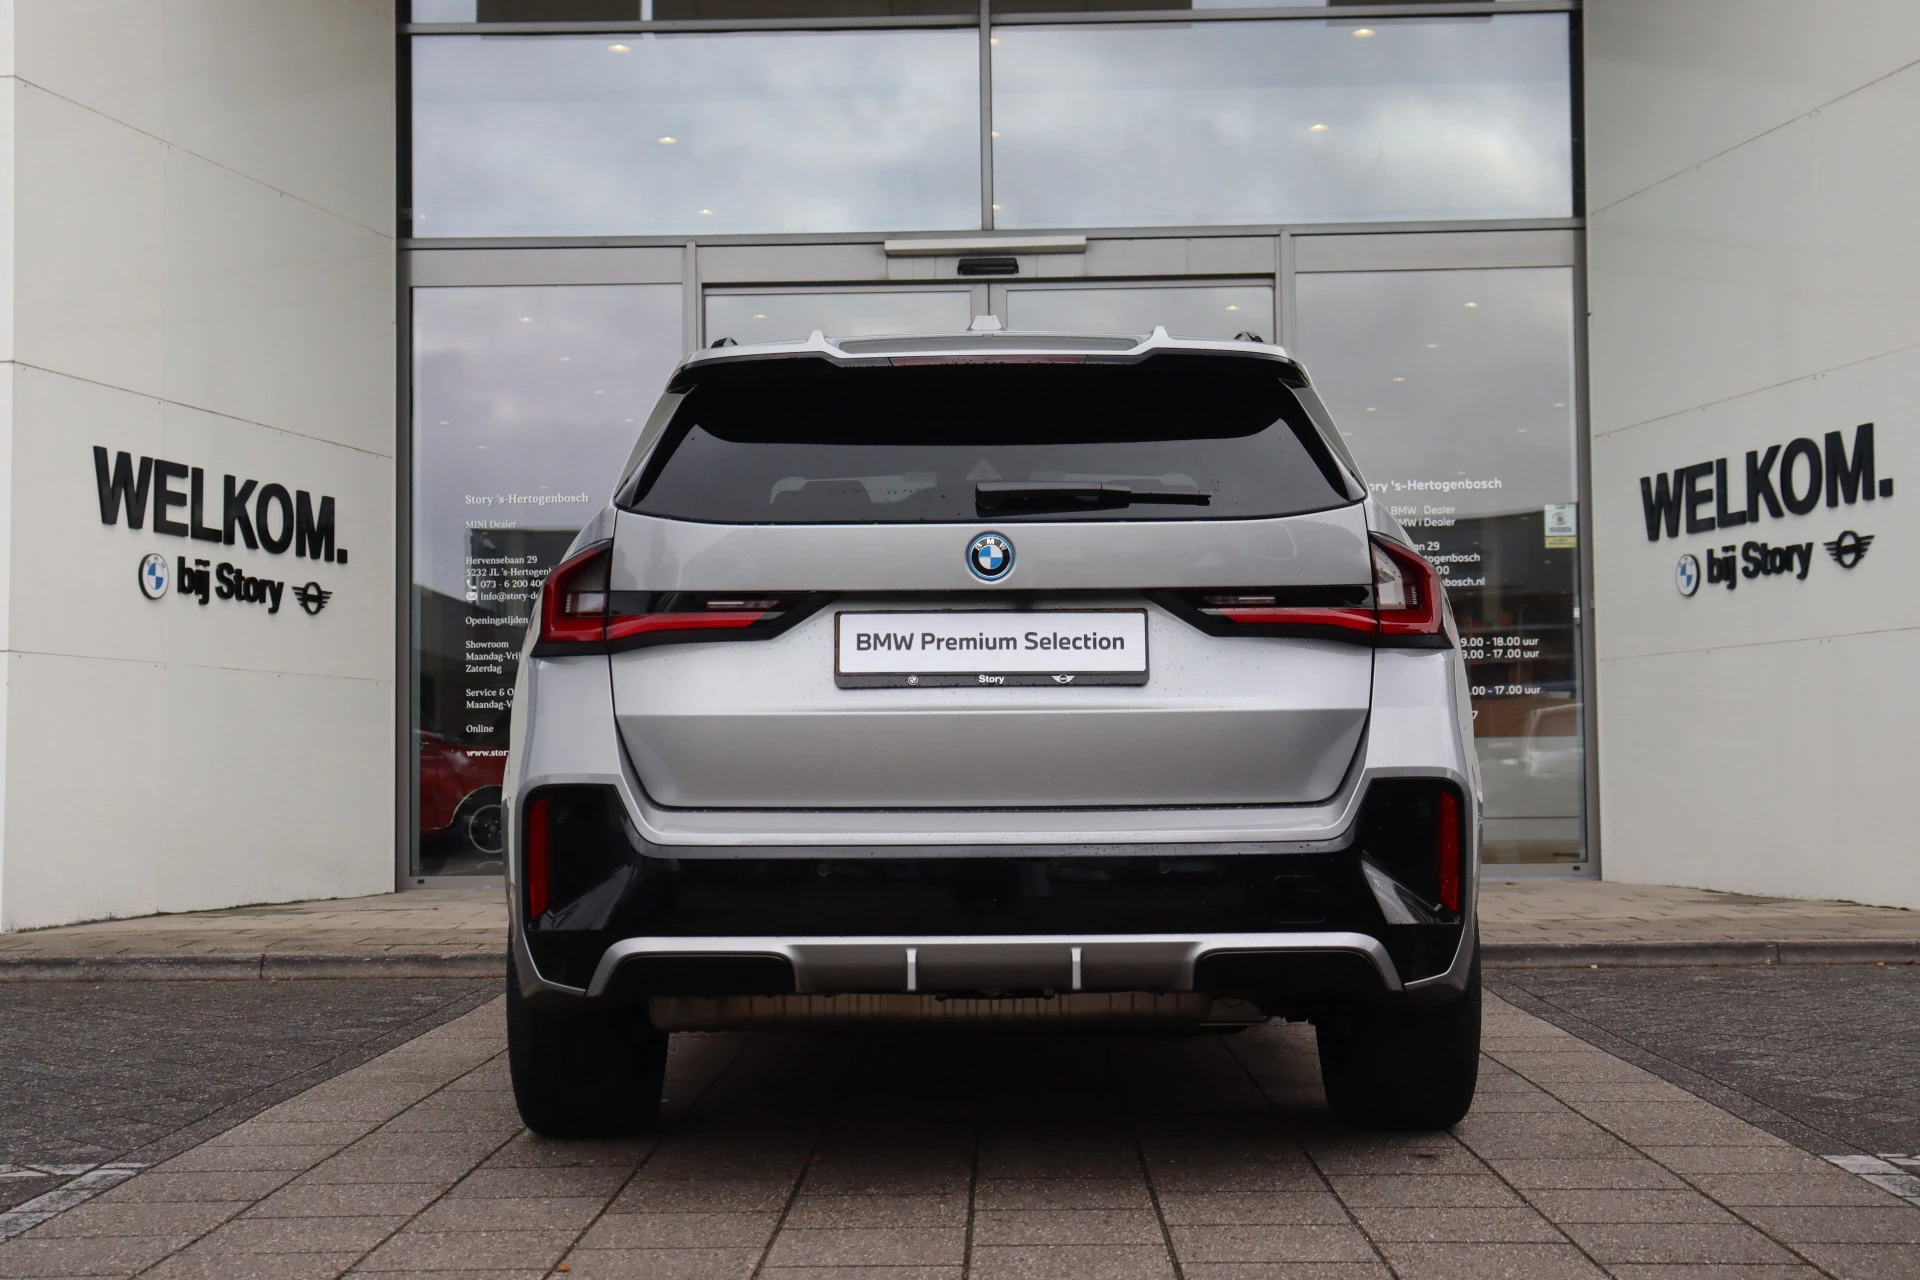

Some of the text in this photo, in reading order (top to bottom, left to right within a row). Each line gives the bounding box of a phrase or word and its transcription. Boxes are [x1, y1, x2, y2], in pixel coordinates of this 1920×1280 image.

[1369, 478, 1502, 493] ory 's-Hertogenbosch
[1640, 422, 1893, 542] WELKOM.
[93, 445, 348, 564] WELKOM.
[465, 493, 589, 506] Story 's-Hertogenbosch
[1391, 505, 1456, 515] BMW Dealer
[489, 520, 516, 528] Dealer
[1398, 518, 1417, 527] MW
[1424, 517, 1456, 527] Dealer
[1427, 541, 1440, 551] 29
[465, 555, 538, 565] Hervensebaan 29
[1707, 540, 1814, 590] bij Story
[465, 567, 552, 578] 5232 JL 's-Hertogen
[1436, 565, 1450, 575] 00
[177, 556, 284, 614] bij Story
[480, 580, 497, 589] 073
[504, 580, 510, 588] 6
[512, 579, 528, 588] 200
[480, 592, 538, 602] info@story-d
[465, 616, 529, 626] Openingstijden
[465, 641, 509, 649] Showroom
[856, 632, 1125, 650] BMW Premium Selection
[1460, 637, 1483, 647] 9.00
[1492, 637, 1520, 646] 18.00
[1462, 650, 1484, 659] 9.00
[1523, 650, 1540, 658] uur
[465, 664, 502, 674] Zaterdag
[978, 674, 1005, 684] Story
[465, 688, 496, 697] Service
[499, 688, 505, 696] &
[466, 724, 494, 733] Online
